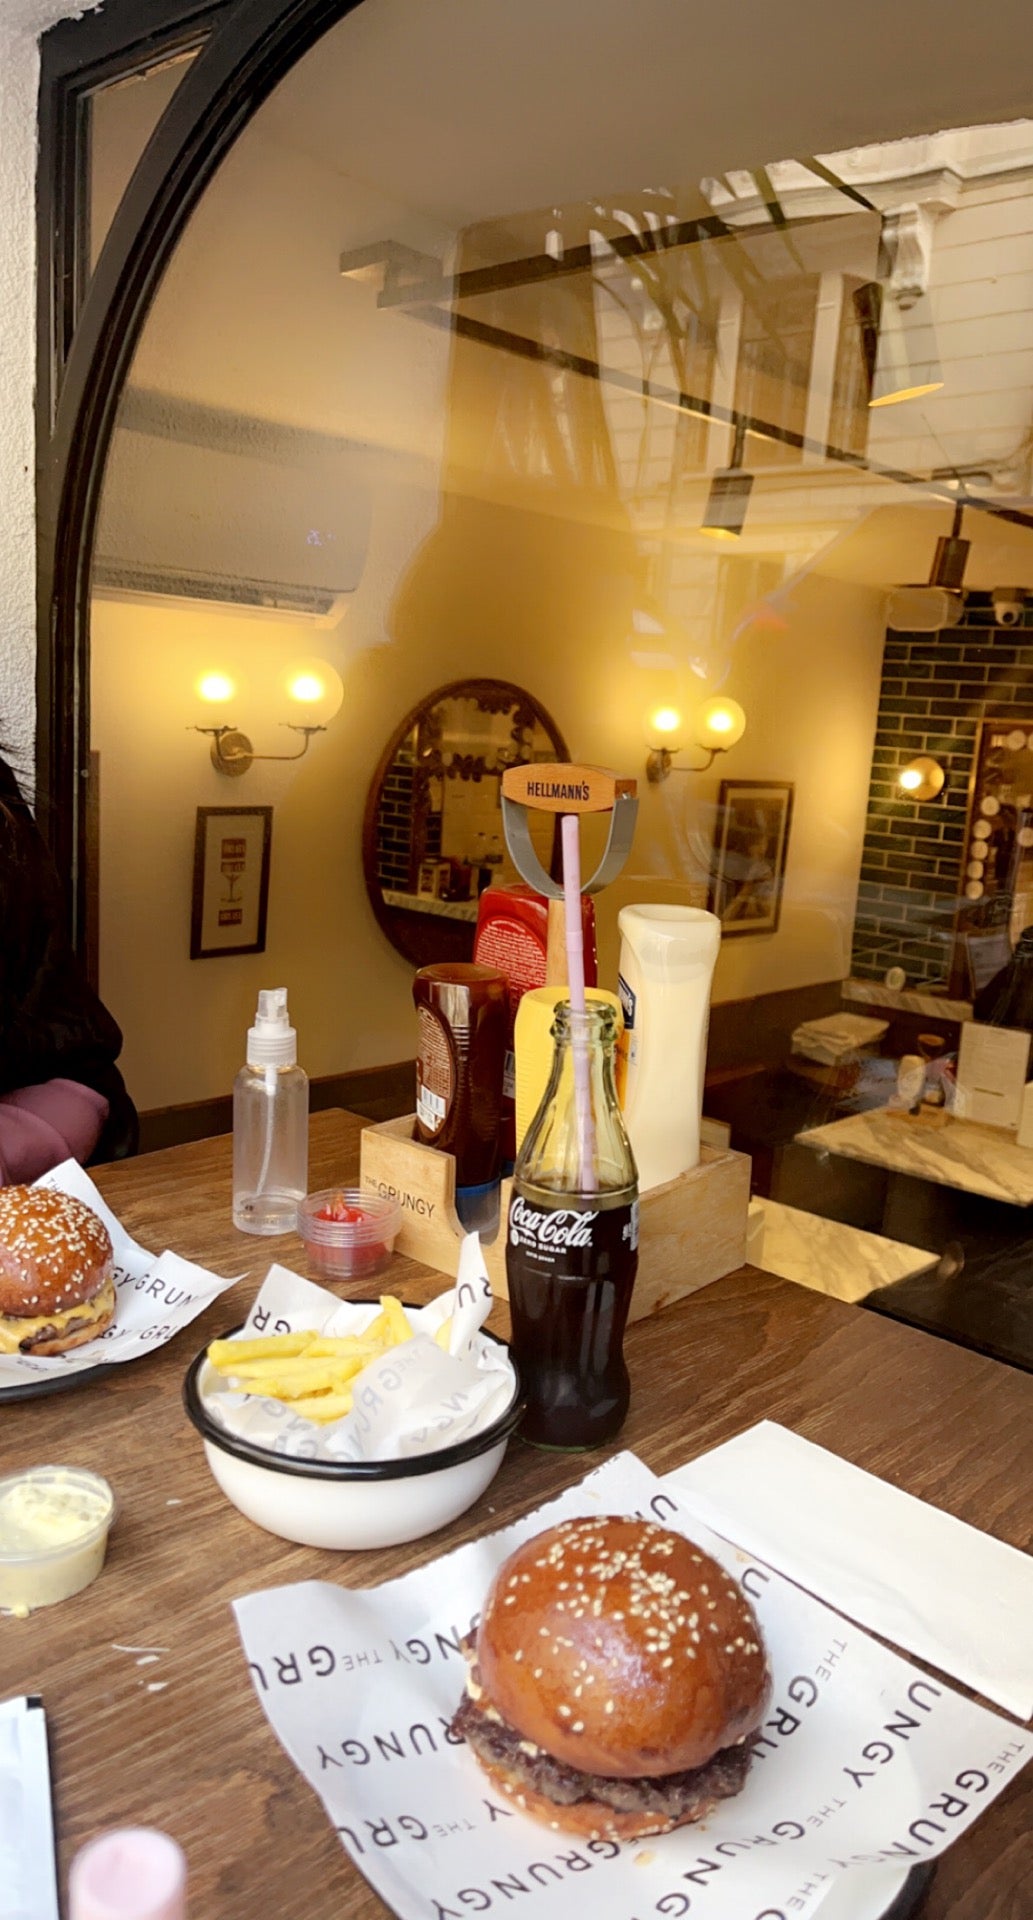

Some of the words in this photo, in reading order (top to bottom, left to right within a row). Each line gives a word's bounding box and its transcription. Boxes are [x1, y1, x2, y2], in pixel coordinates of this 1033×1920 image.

[527, 780, 590, 801] HELLMANN'S
[377, 1182, 435, 1219] GRUNGY
[509, 1196, 600, 1248] Coca-Cola
[538, 1242, 567, 1255] SUGAR
[342, 1649, 383, 1672] THE
[815, 1639, 848, 1682] THE
[986, 1741, 1026, 1775] THE
[432, 1818, 478, 1838] THE
[806, 1797, 848, 1828] THE
[430, 1838, 621, 1920] GRUNGY
[786, 1872, 830, 1911] THE
